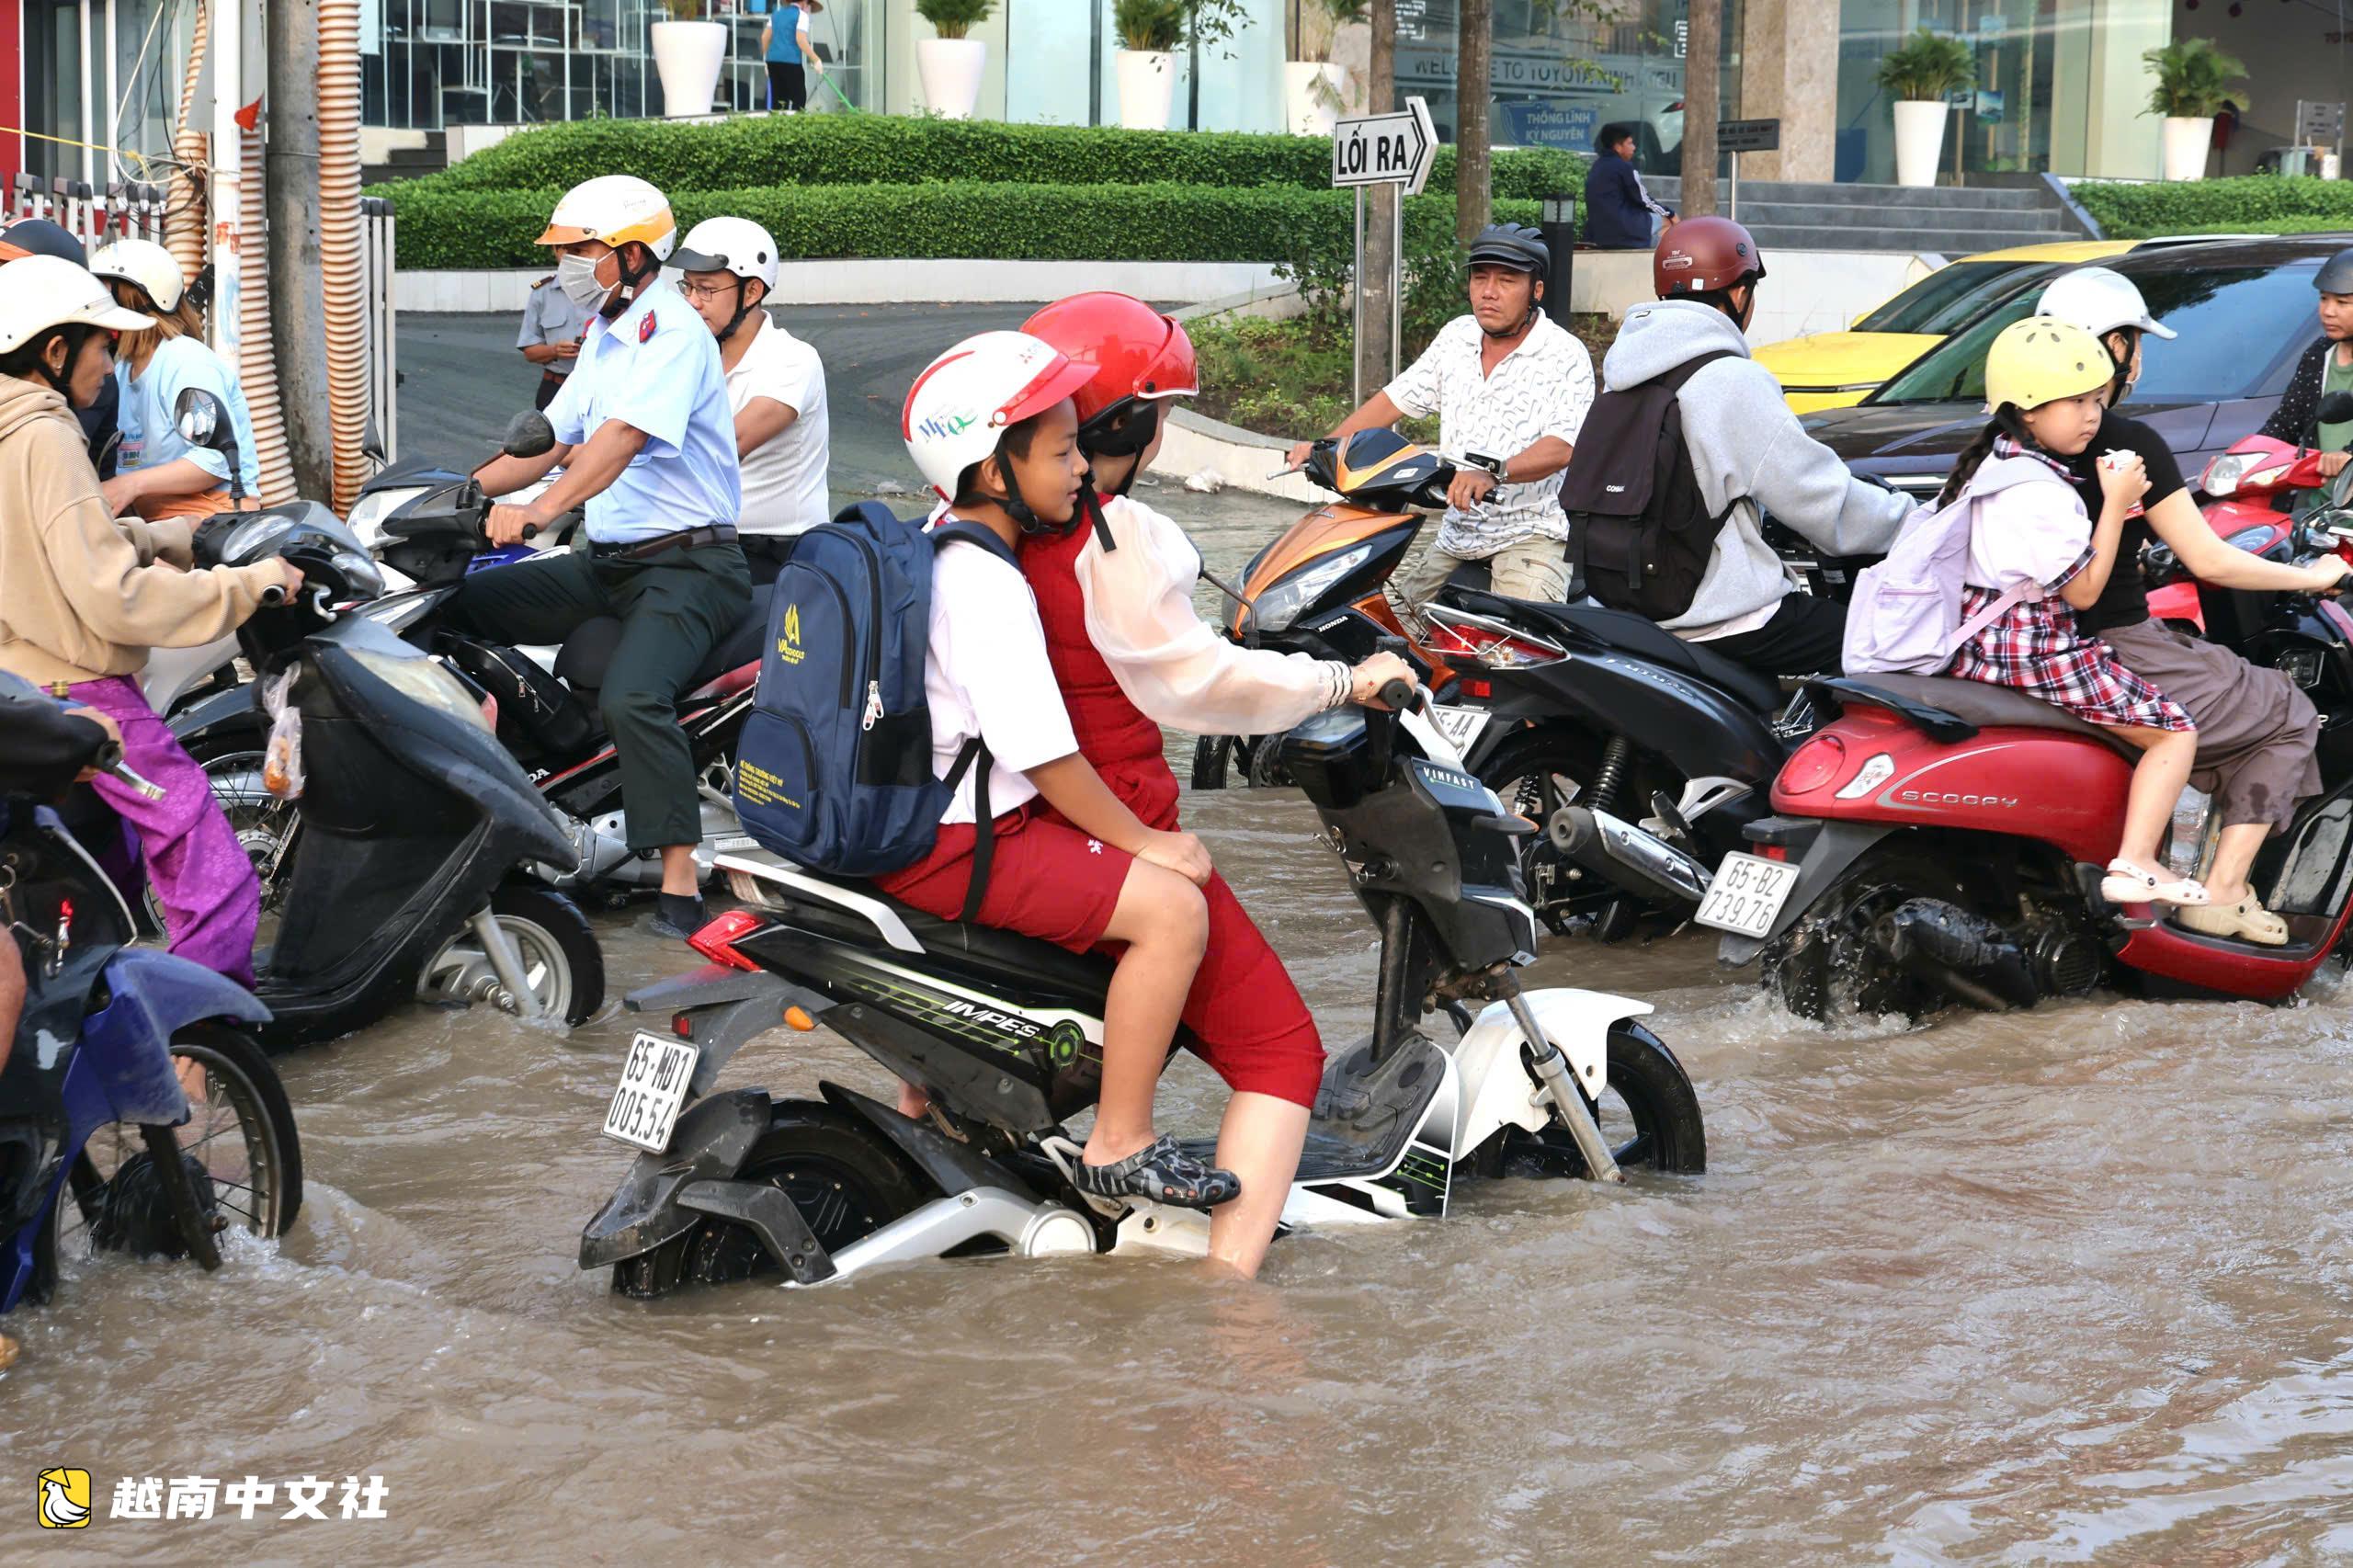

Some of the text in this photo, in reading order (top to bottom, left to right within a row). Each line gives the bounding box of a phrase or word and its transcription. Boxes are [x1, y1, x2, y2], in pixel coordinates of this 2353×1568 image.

[1504, 61, 1524, 80] TO
[1337, 123, 1407, 176] LỐI RA
[1318, 615, 1348, 632] HONDA
[1423, 767, 1475, 790] VINFAST
[1902, 790, 2018, 808] SCOOPY
[1726, 859, 1784, 898] 65-B2
[1702, 889, 1775, 931] 739.76
[942, 1000, 1040, 1038] IMPES
[608, 1086, 674, 1145] 005.54
